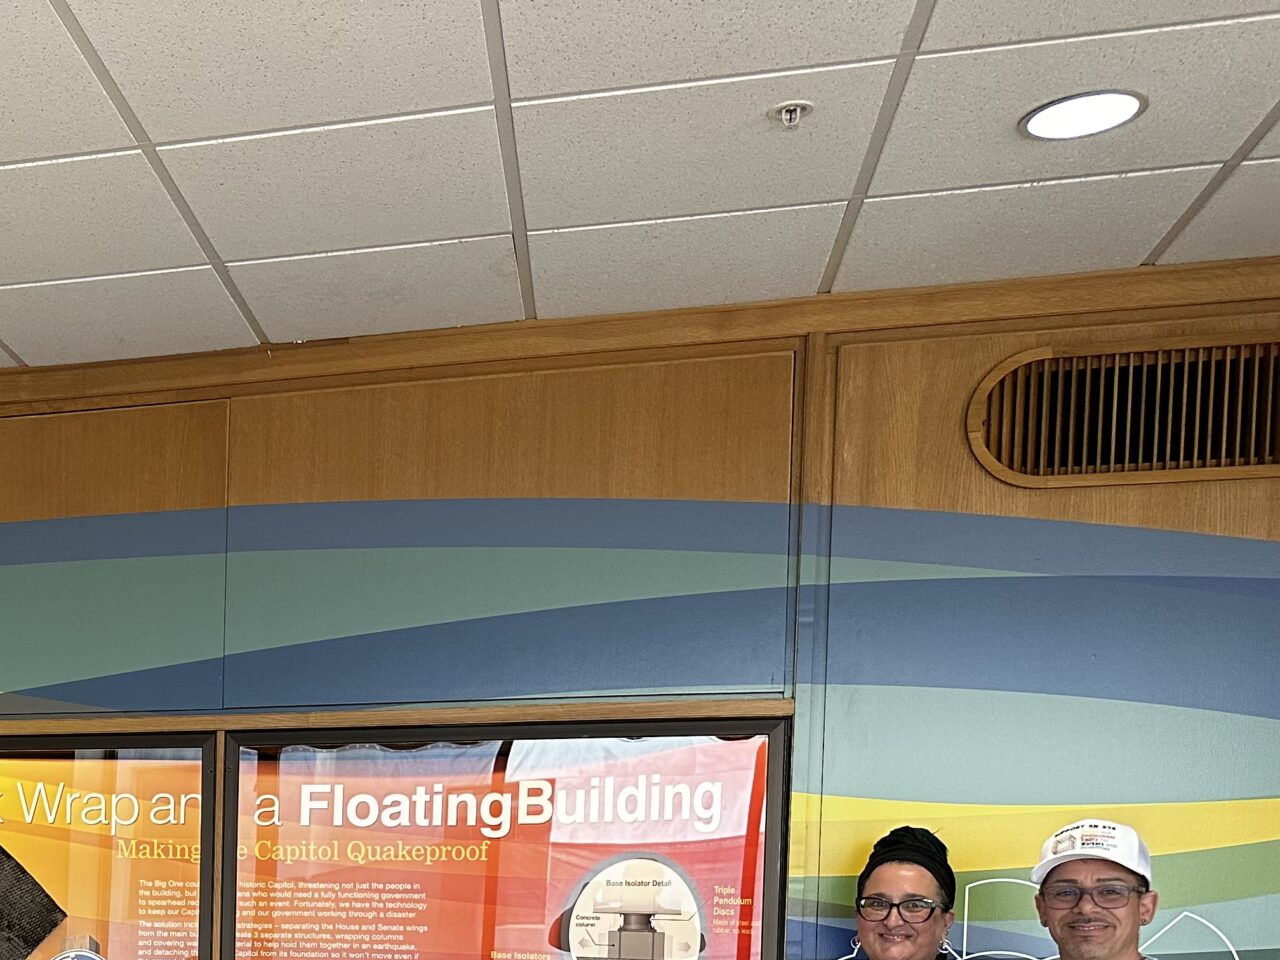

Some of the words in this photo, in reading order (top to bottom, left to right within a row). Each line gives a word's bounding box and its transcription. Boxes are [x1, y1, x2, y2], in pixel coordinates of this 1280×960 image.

[17, 782, 139, 836] Wrap
[149, 792, 201, 826] an
[253, 793, 282, 826] a
[300, 784, 512, 839] Floating
[518, 775, 721, 834] Building
[116, 839, 201, 863] Making
[254, 841, 339, 864] Capitol
[347, 841, 491, 865] Quakeproof
[298, 882, 339, 890] threatening
[714, 886, 735, 895] Triple
[294, 900, 336, 909] Fortunately,
[386, 902, 427, 910] technology
[714, 897, 752, 905] Pendulum
[317, 910, 347, 918] working
[349, 911, 377, 919] through
[714, 907, 735, 916] Discs
[406, 925, 428, 933] wings
[294, 932, 332, 940] structures,
[320, 942, 351, 950] together
[491, 951, 511, 959] Base
[514, 952, 551, 960] Isolators
